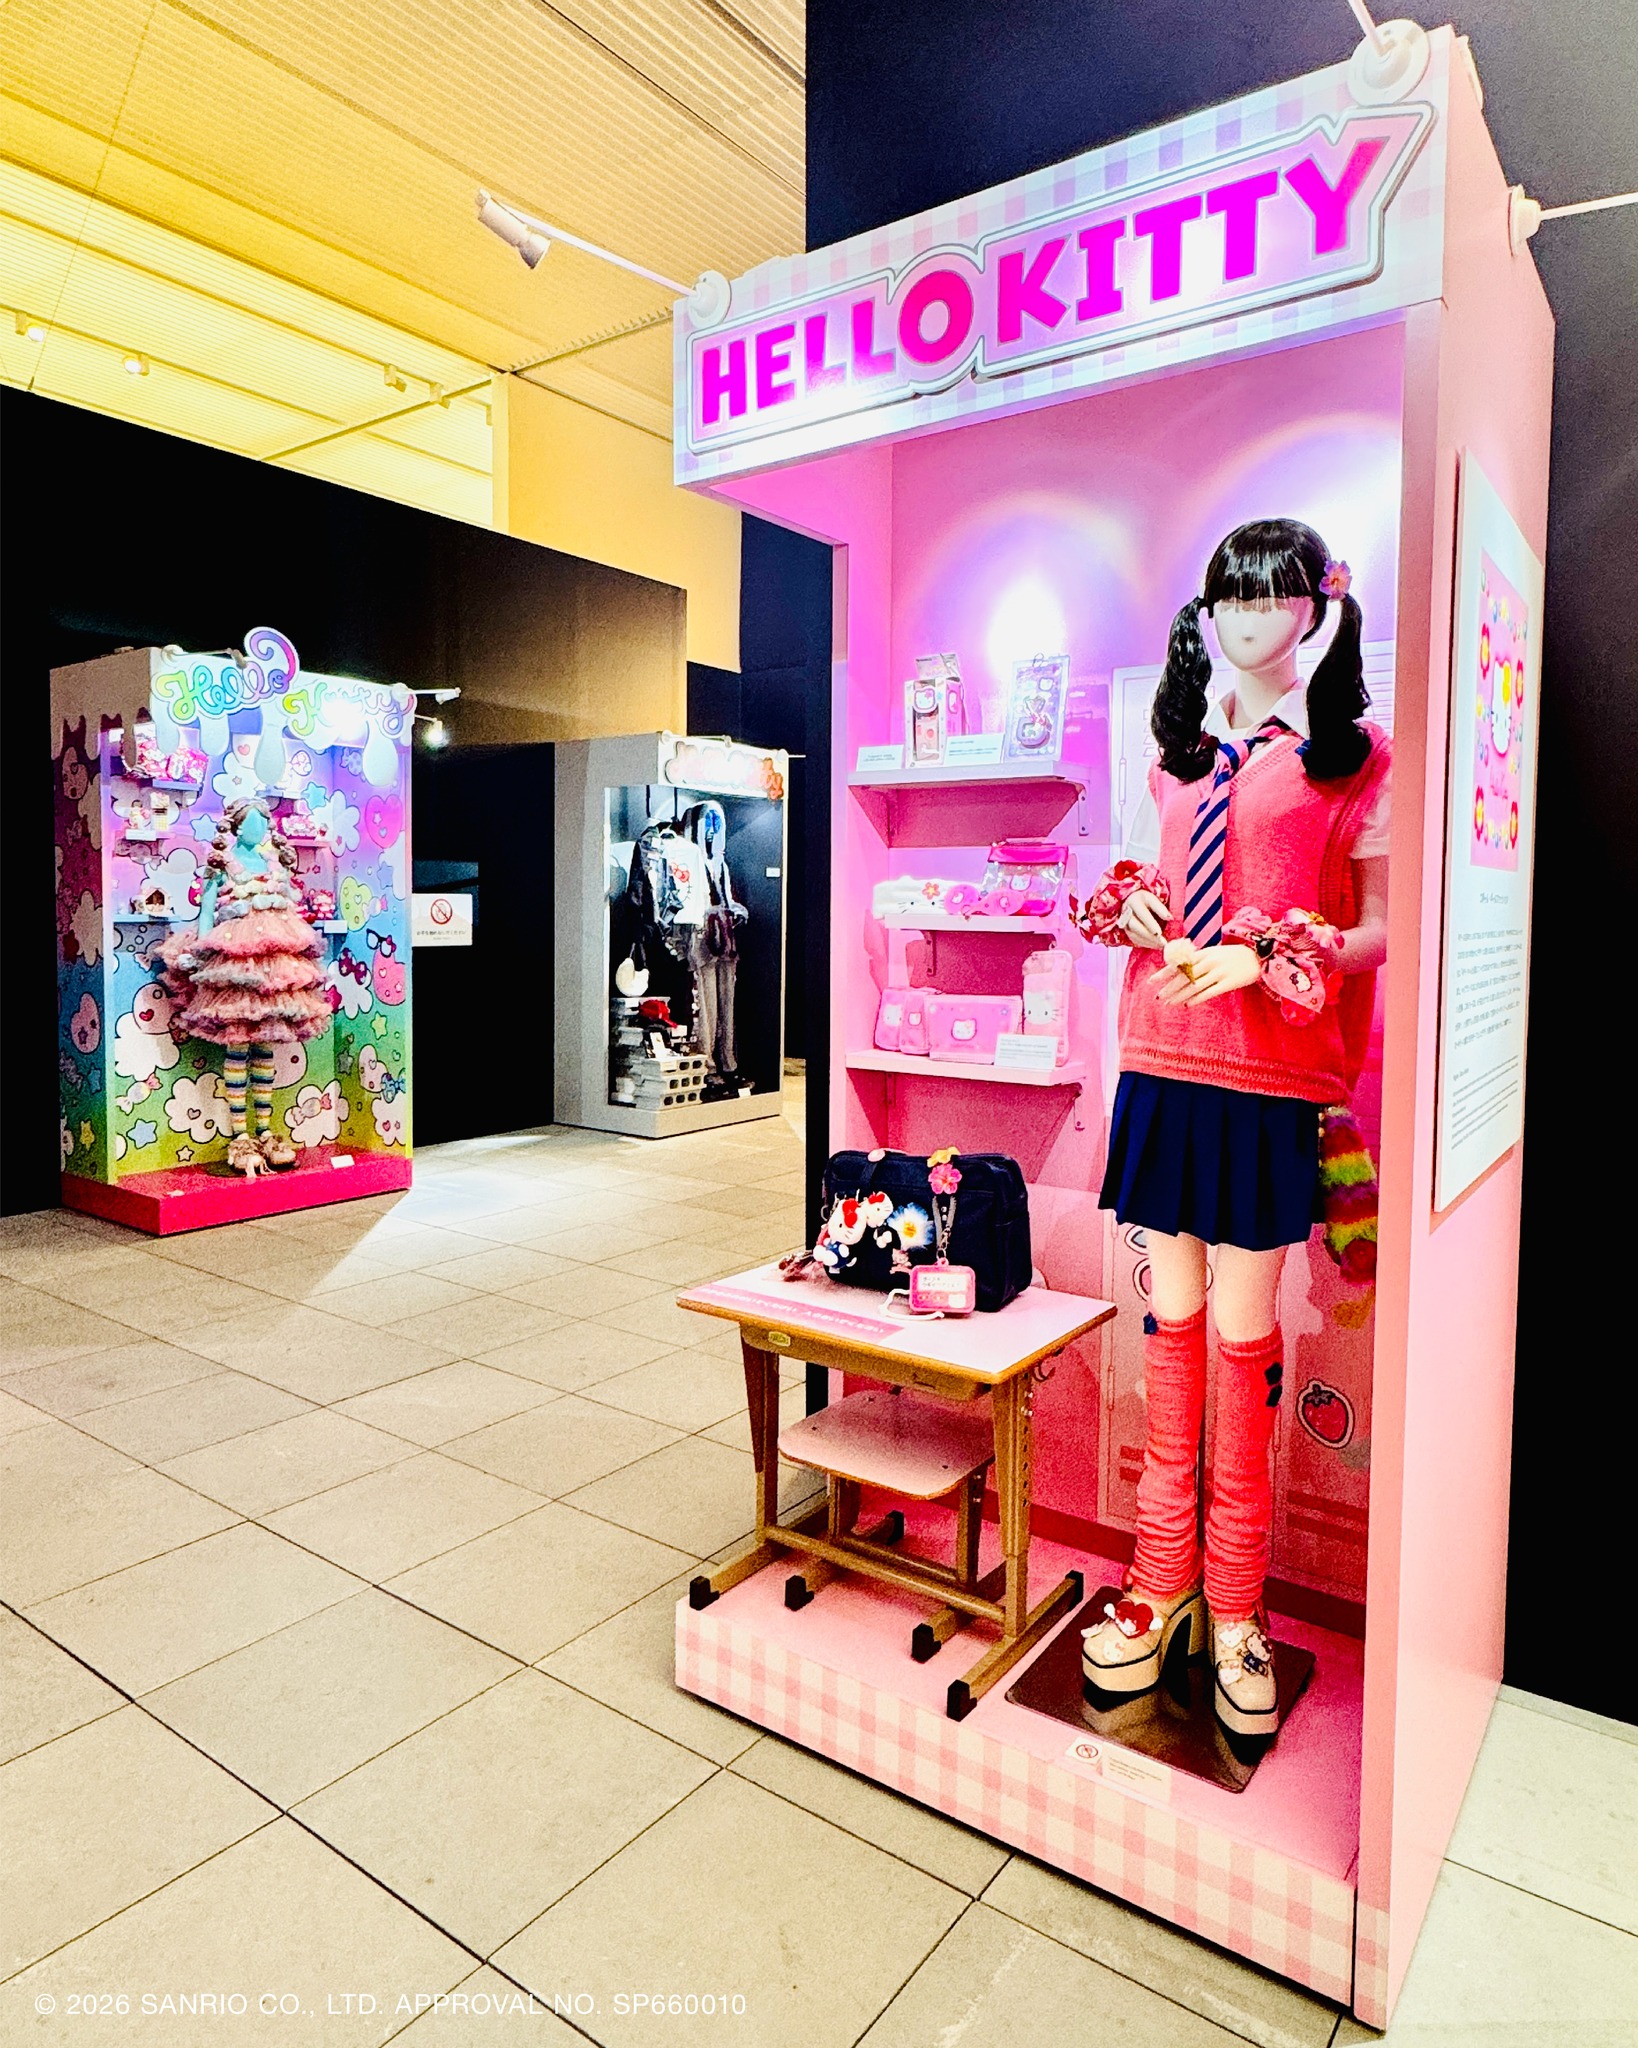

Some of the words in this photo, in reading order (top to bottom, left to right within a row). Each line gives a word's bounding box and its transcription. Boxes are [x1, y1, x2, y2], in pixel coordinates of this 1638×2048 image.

[700, 267, 976, 426] HELLO
[995, 135, 1389, 345] KITTY
[155, 630, 297, 721] Hello
